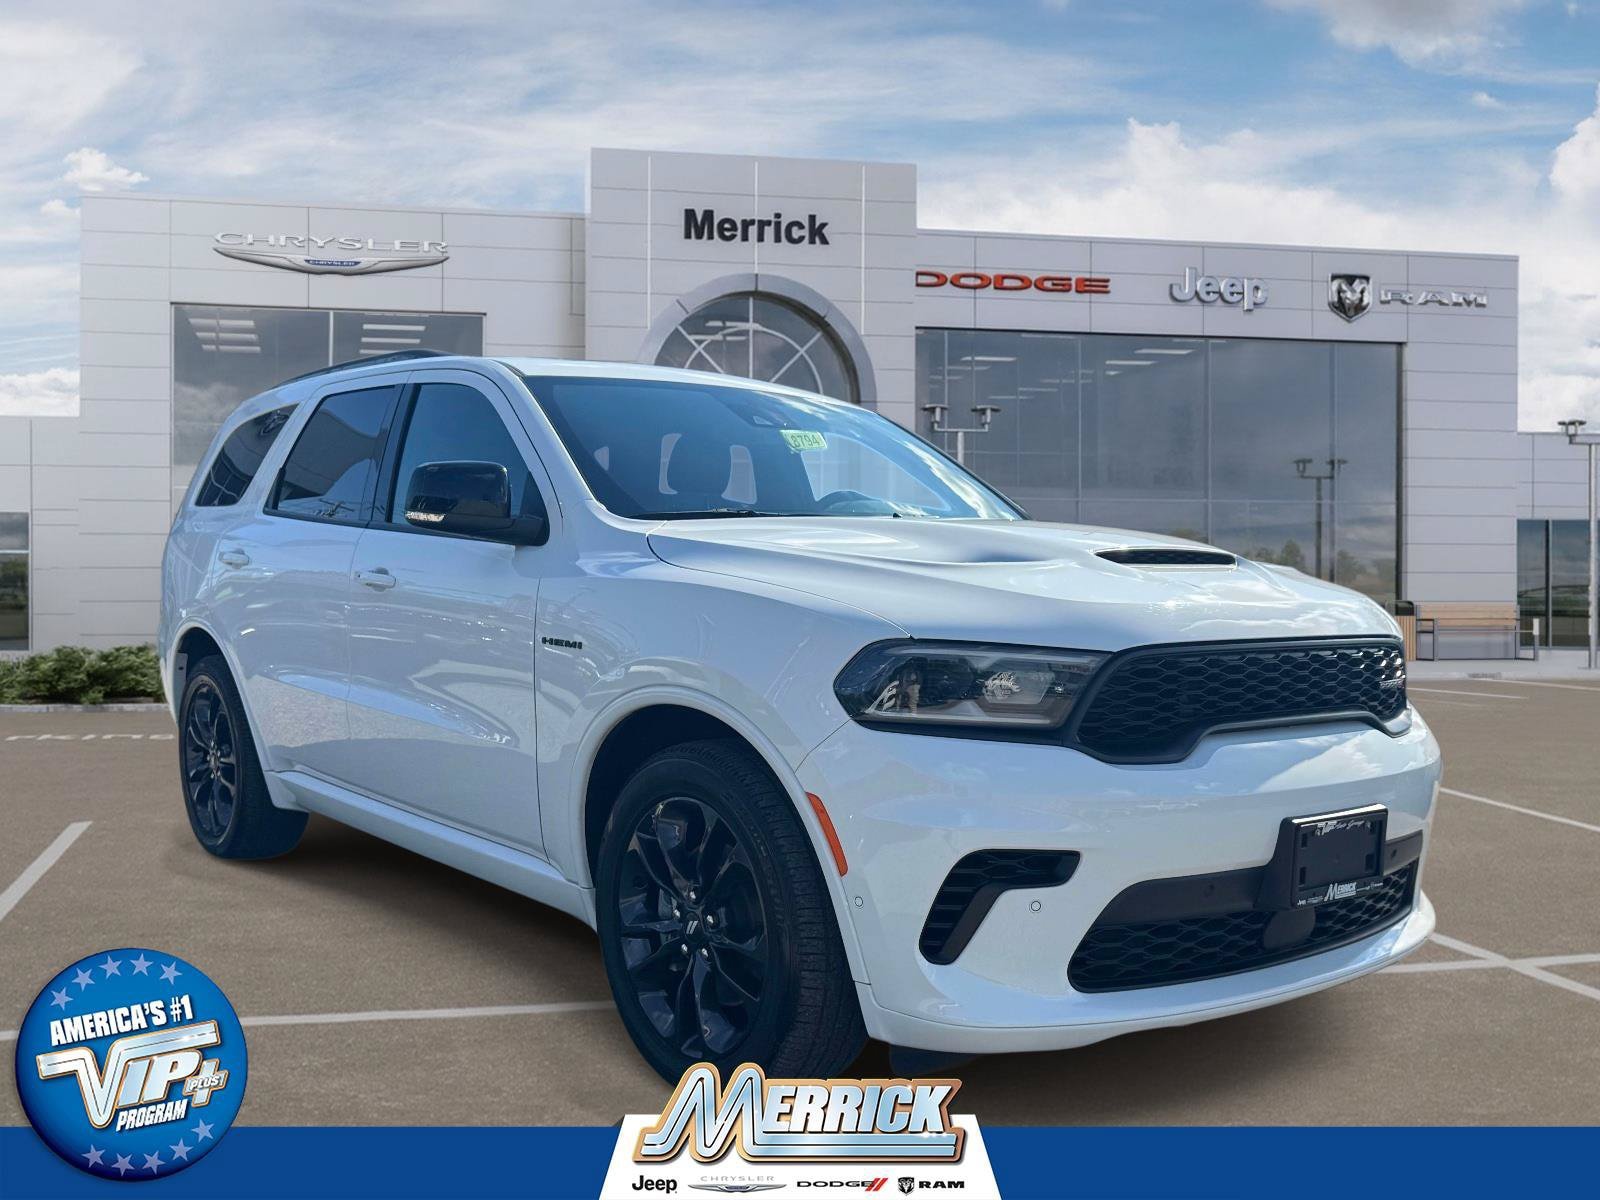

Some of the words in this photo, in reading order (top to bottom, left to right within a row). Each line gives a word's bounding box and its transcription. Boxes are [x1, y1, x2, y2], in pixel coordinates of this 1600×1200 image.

[684, 208, 830, 245] Merrick
[214, 232, 449, 254] CHRYSLER
[914, 271, 1111, 294] DODGE
[1169, 267, 1267, 312] Jeep
[1379, 290, 1488, 308] RAM
[541, 636, 583, 650] HEMI
